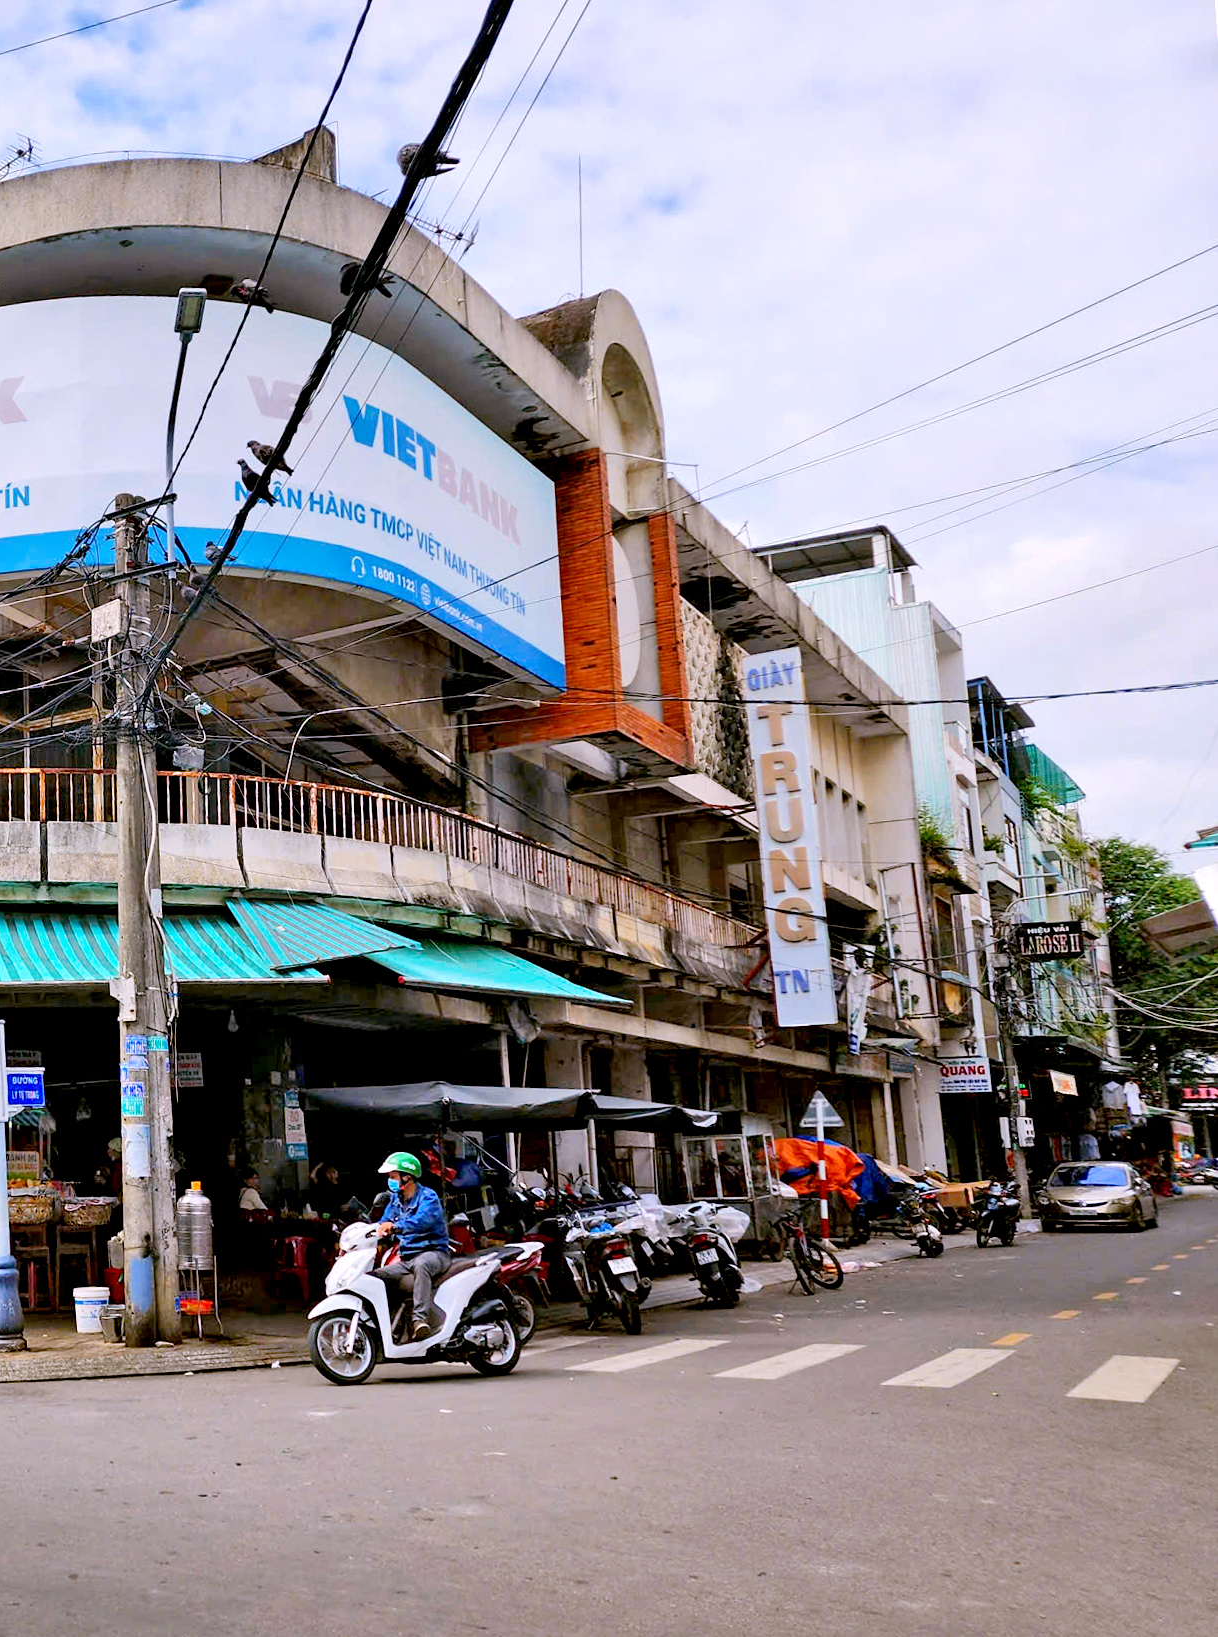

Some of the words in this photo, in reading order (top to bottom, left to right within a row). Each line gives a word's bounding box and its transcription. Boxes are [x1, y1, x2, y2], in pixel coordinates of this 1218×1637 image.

[343, 395, 520, 546] VIETBANK
[235, 480, 303, 509] NÂN
[310, 490, 366, 524] HÀNG
[370, 507, 413, 541] TMCP
[416, 529, 441, 561] VIỆT
[444, 546, 468, 579] NAM
[469, 564, 509, 605] THƯƠNG
[510, 591, 526, 616] TÍN
[372, 565, 394, 583] 1800
[397, 574, 416, 593] 1122
[747, 659, 795, 691] GIÀY
[756, 704, 818, 943] TRUNG
[12, 1075, 38, 1085] ĐƯỜNG
[940, 1065, 985, 1077] QUANG
